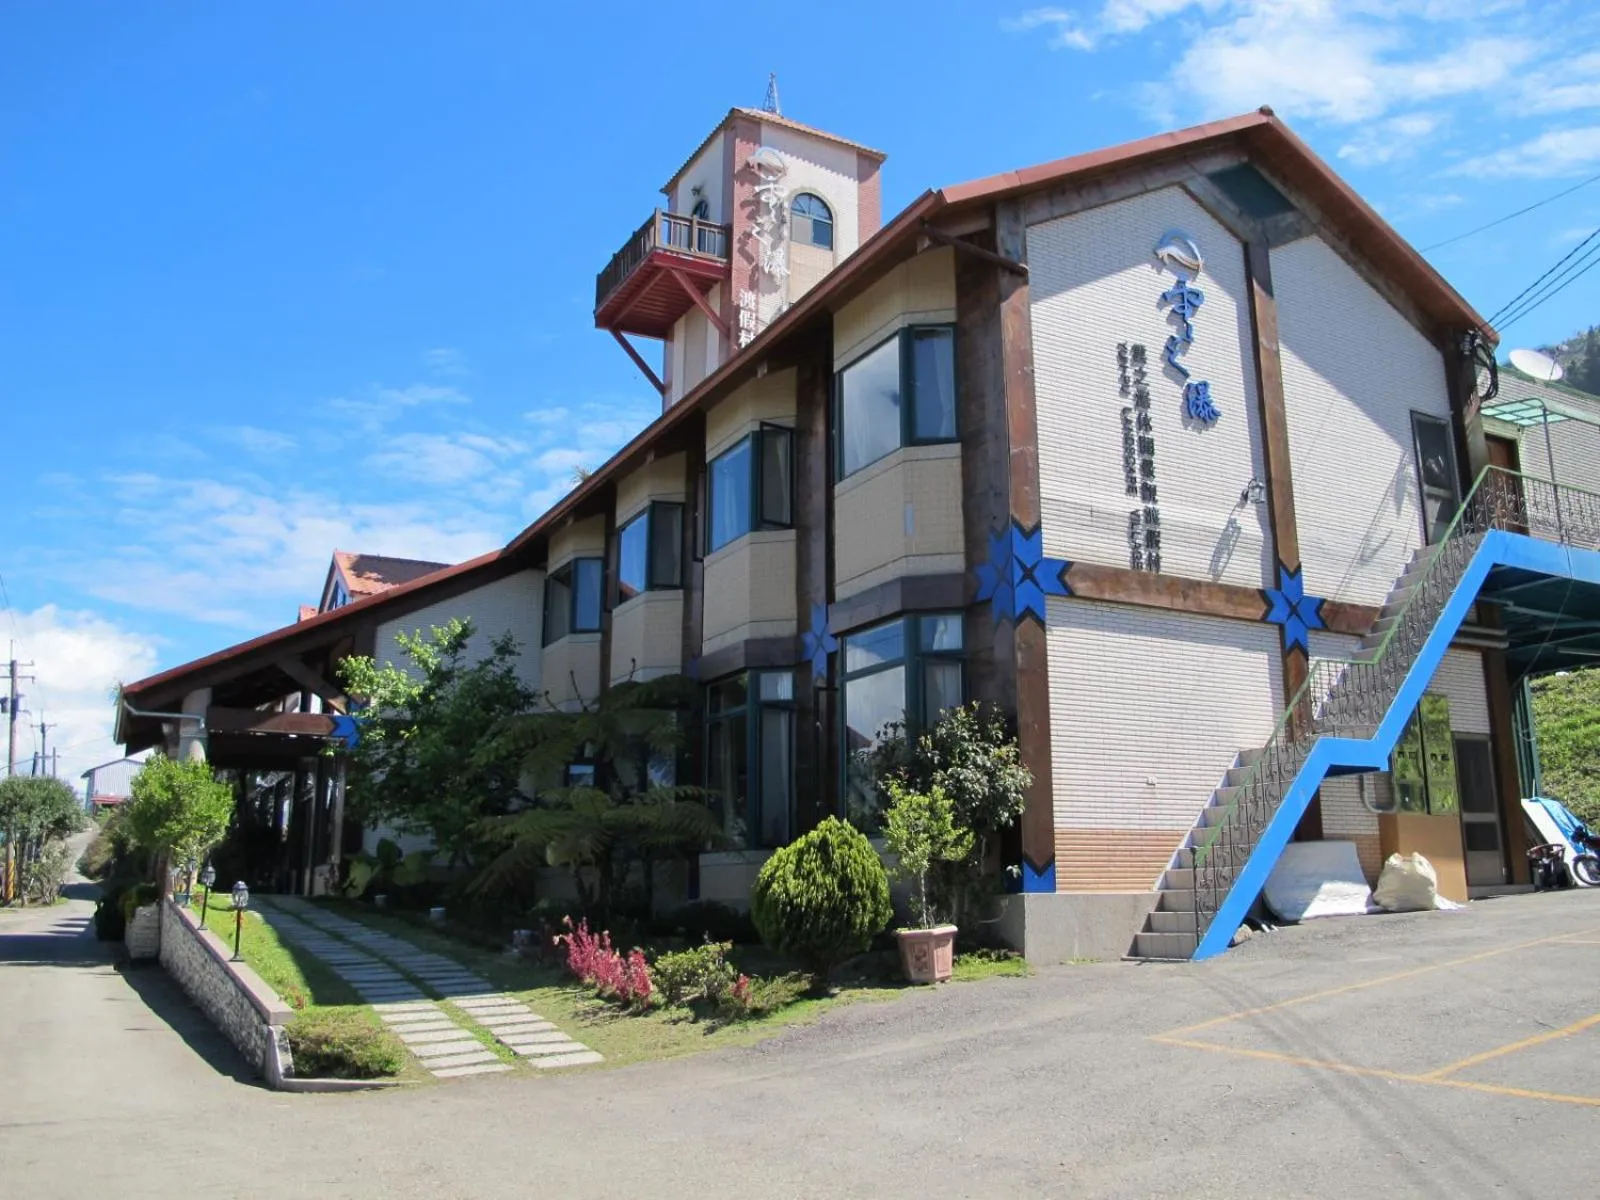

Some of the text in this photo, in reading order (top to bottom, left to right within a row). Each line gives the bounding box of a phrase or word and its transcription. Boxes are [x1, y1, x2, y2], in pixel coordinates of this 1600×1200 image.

[739, 289, 757, 349] 渡假村
[1121, 406, 1138, 496] LANDSCAPE
[1128, 509, 1143, 570] VILLAGE
